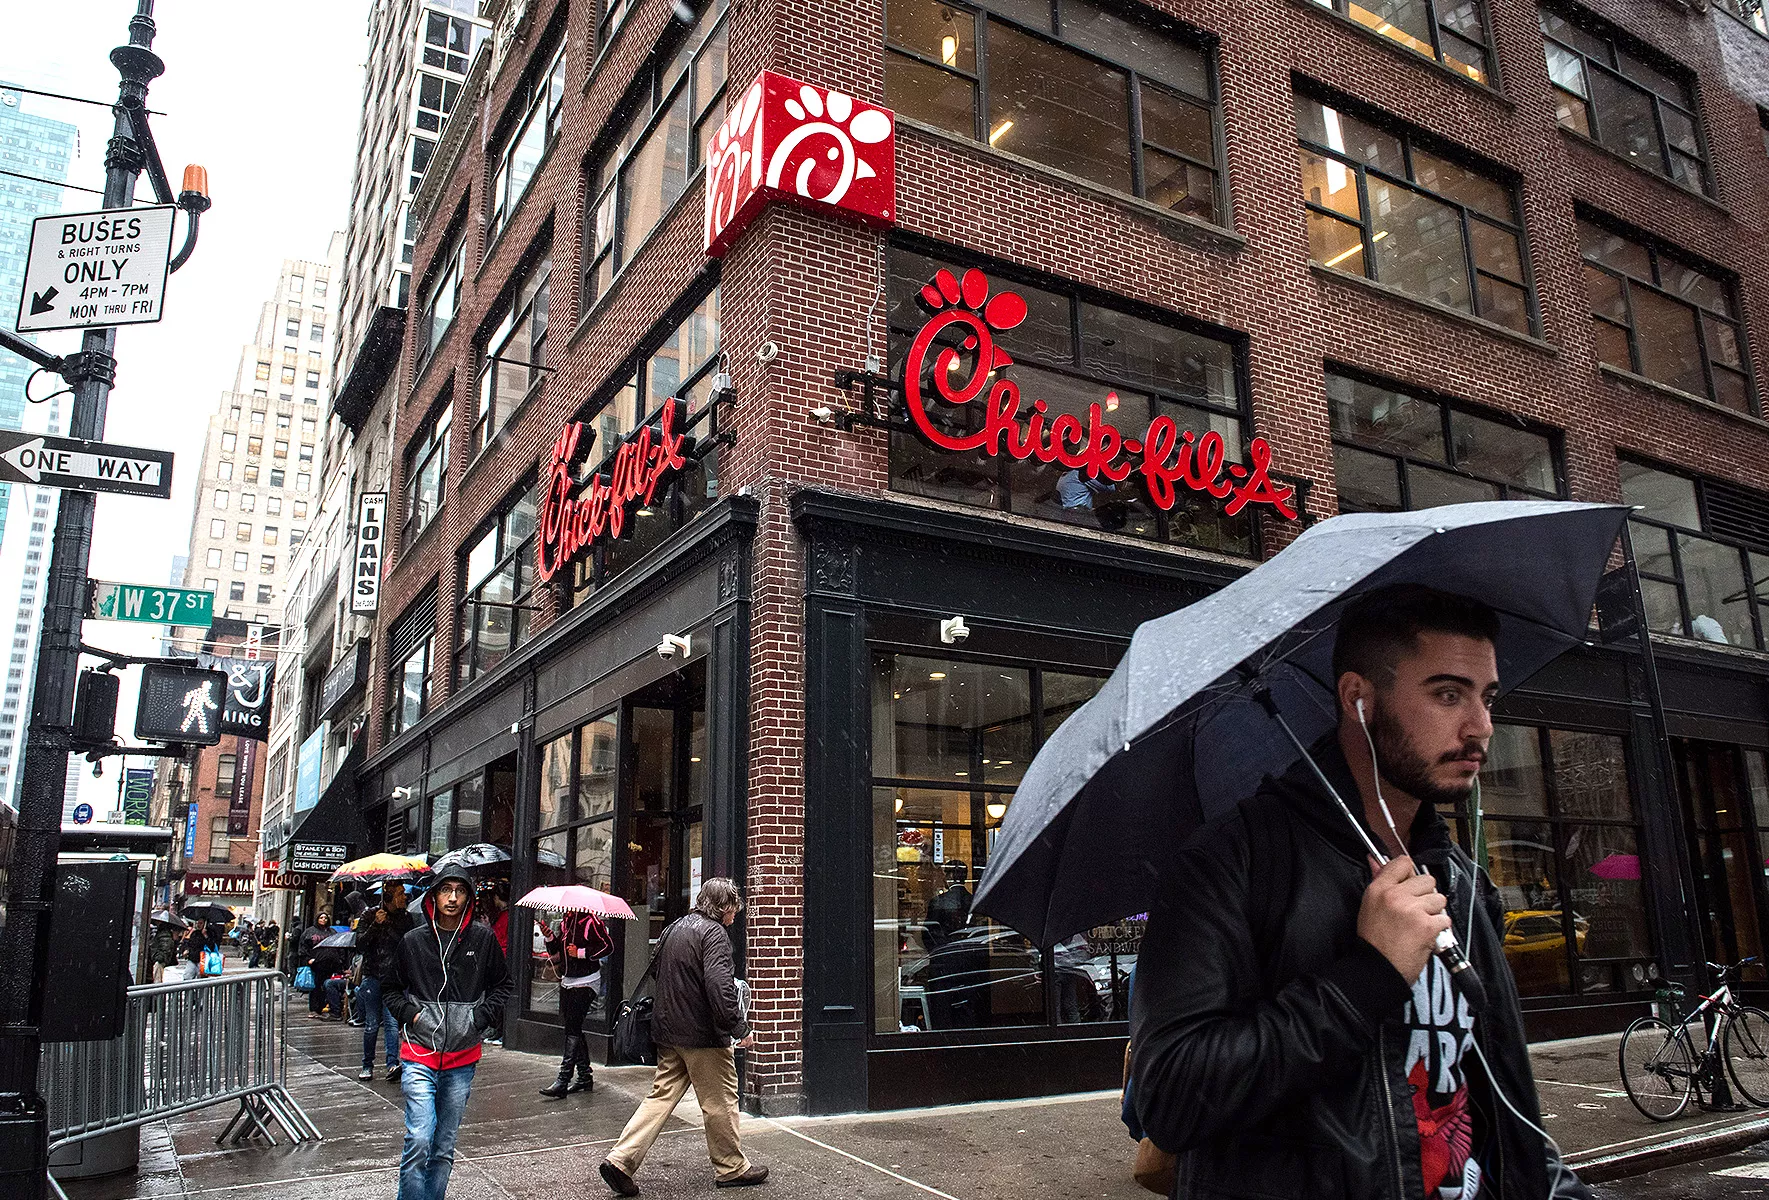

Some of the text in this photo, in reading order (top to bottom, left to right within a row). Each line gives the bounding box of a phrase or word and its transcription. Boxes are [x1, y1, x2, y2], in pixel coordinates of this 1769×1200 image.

[61, 217, 141, 245] BUSES
[57, 243, 141, 259] & RIGHT TURNS
[64, 258, 129, 284] ONLY
[69, 301, 154, 320] MON THRU FRI
[905, 300, 1298, 520] Chick-fil-A
[19, 448, 151, 481] ONE WAY
[364, 497, 384, 505] CASH
[538, 405, 686, 582] Chick-fil-A
[357, 508, 380, 596] LOANS
[124, 589, 208, 621] W 37 ST
[214, 662, 267, 709] &J
[241, 754, 249, 774] WHERE
[126, 777, 150, 818] WORK
[296, 844, 325, 852] STANLEY
[294, 861, 310, 869] CASH
[311, 862, 331, 870] DEPOT
[202, 877, 225, 892] PRET
[225, 879, 233, 892] A
